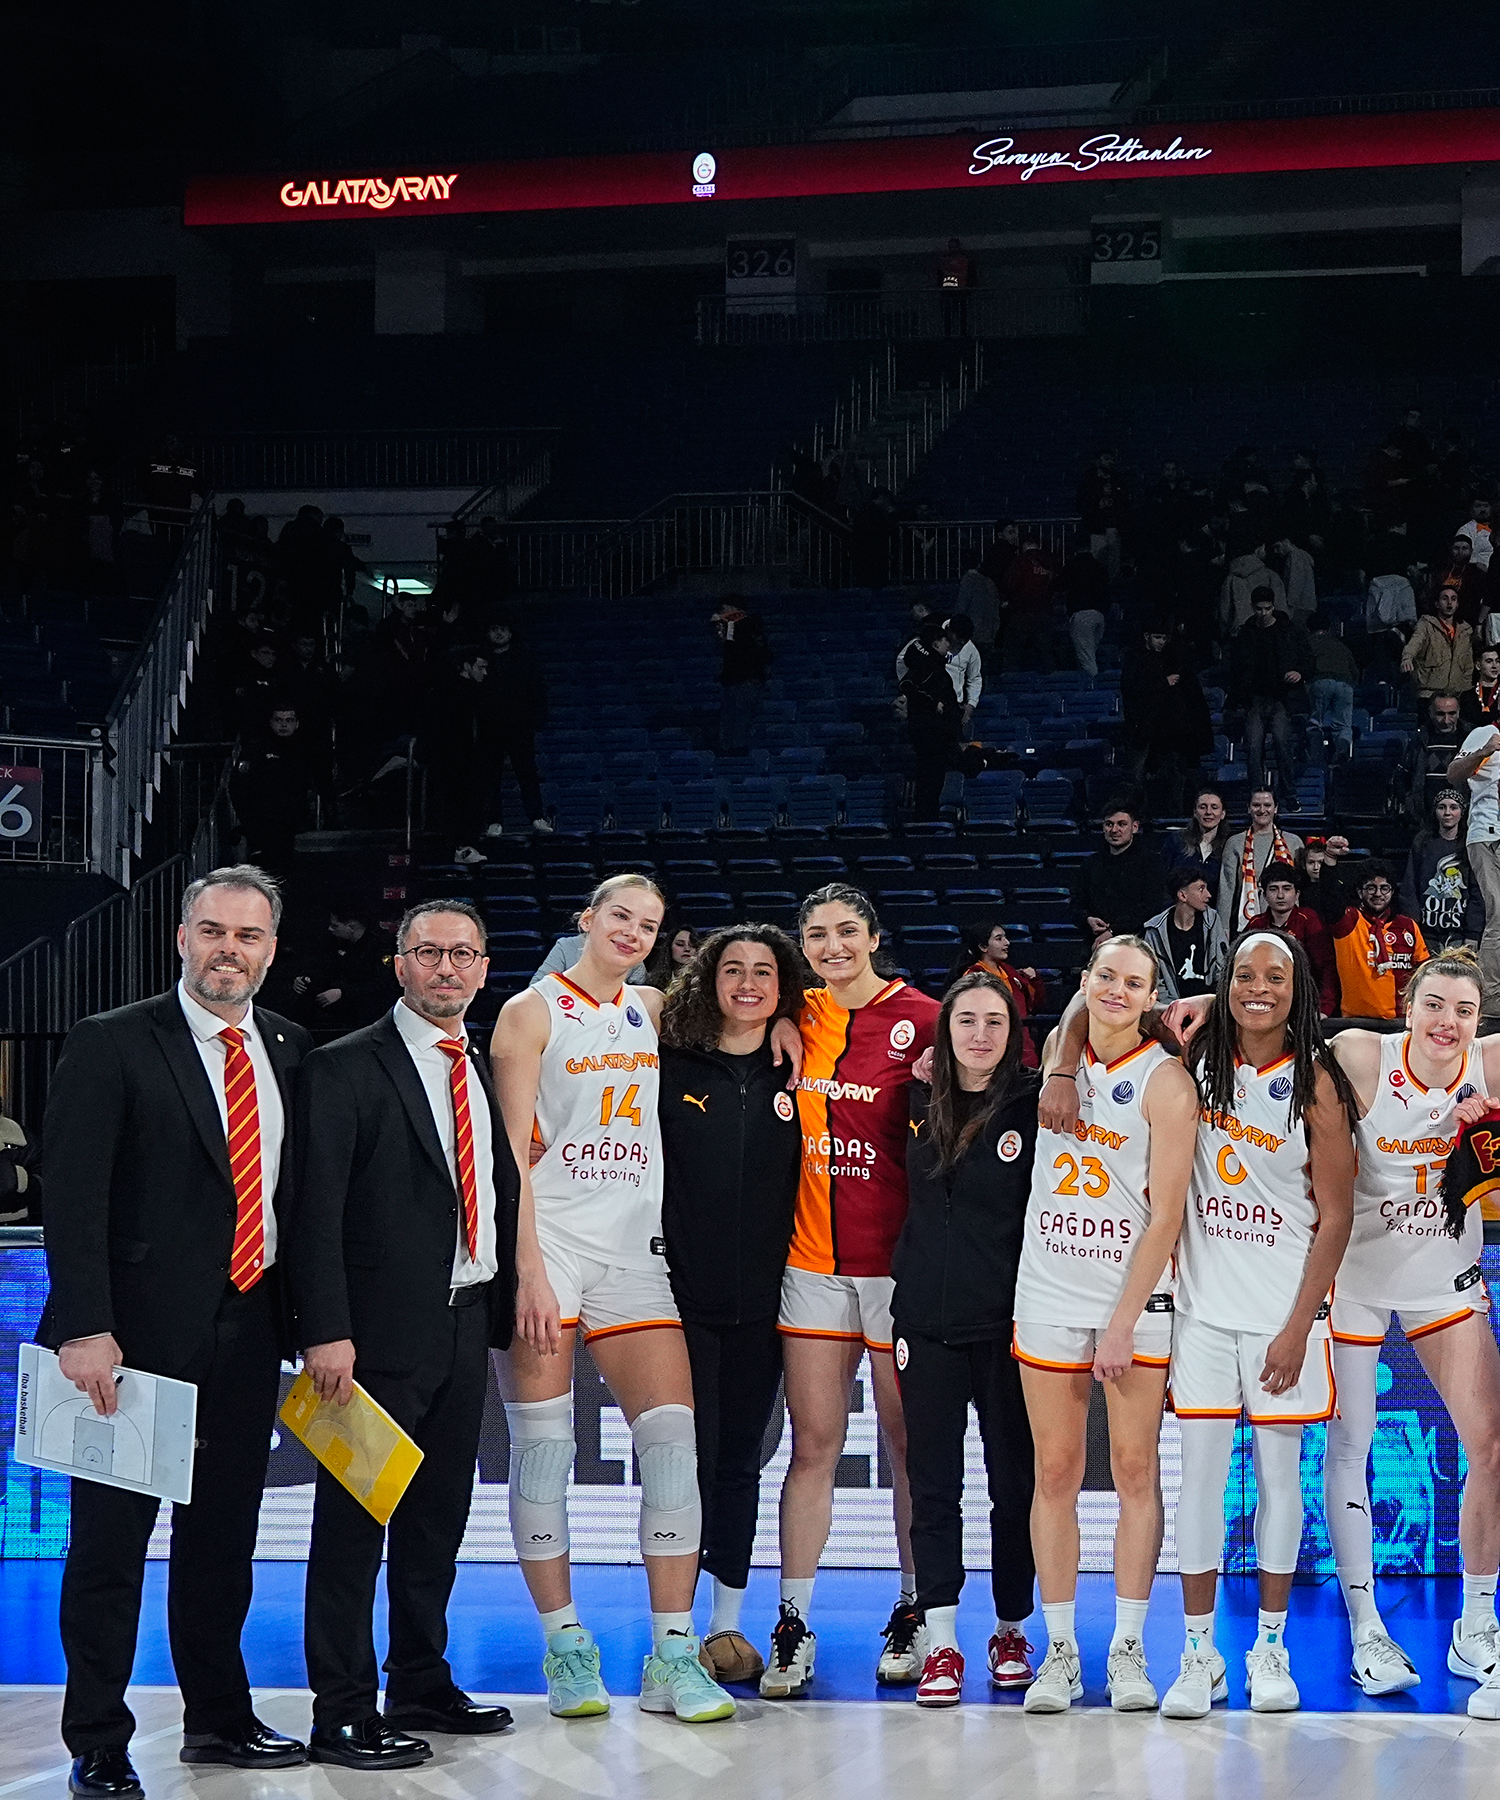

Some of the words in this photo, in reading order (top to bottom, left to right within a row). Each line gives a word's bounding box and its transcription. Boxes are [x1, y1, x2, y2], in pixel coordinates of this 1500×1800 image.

[281, 173, 459, 209] GALATASARAY
[732, 249, 794, 278] 326
[1094, 231, 1159, 262] 325
[600, 1084, 642, 1126] 14
[562, 1137, 649, 1170] ÇAĞDAŞ
[803, 1131, 877, 1165] AĞDAŞ
[571, 1167, 642, 1187] faktoring
[1052, 1152, 1111, 1198] 23
[1040, 1210, 1132, 1245] ÇAĞDAŞ
[1197, 1194, 1284, 1231] ÇAĞDAŞ
[1046, 1238, 1123, 1263] faktoring
[1203, 1221, 1276, 1248] faktoring
[19, 1373, 30, 1436] fiba.basketball
